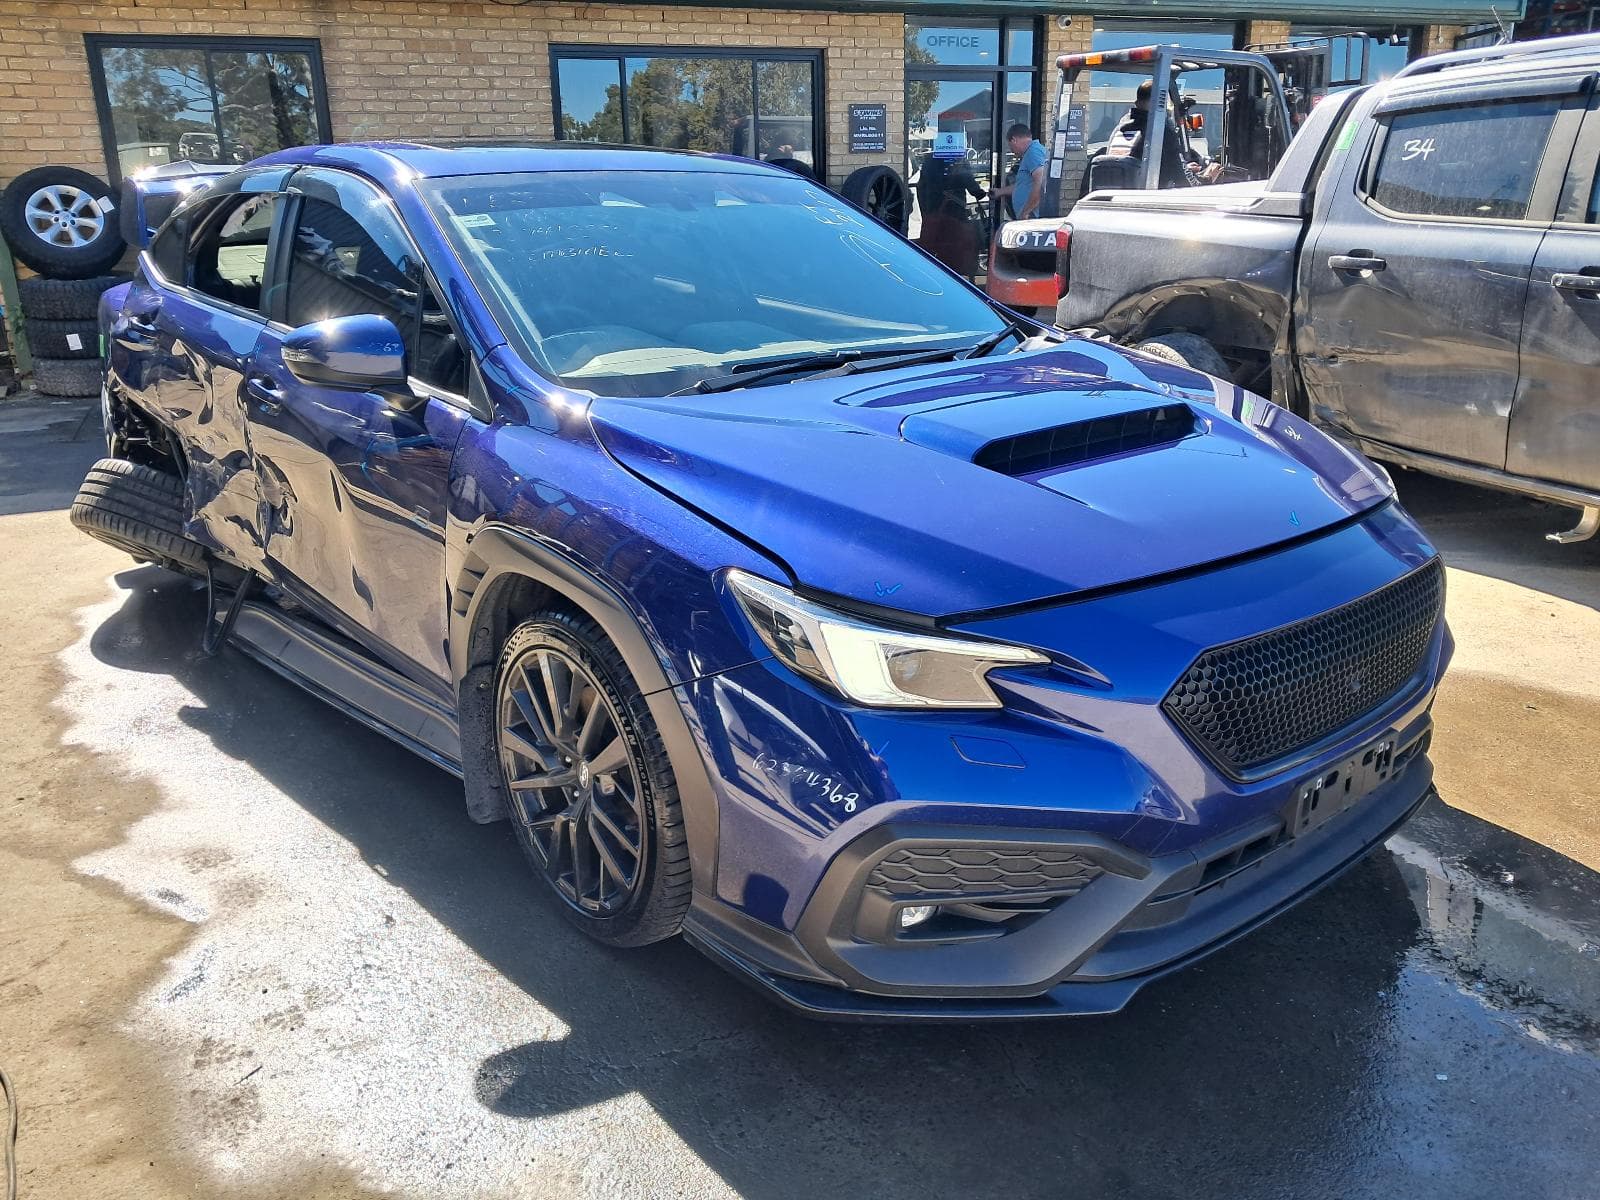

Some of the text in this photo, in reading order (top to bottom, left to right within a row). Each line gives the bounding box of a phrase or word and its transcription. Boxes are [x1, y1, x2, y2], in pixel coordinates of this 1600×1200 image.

[927, 35, 979, 47] OFFICE
[1401, 138, 1436, 161] 34
[593, 667, 637, 746] MICHELIN
[636, 757, 650, 786] PILOT
[644, 788, 655, 824] SPORT
